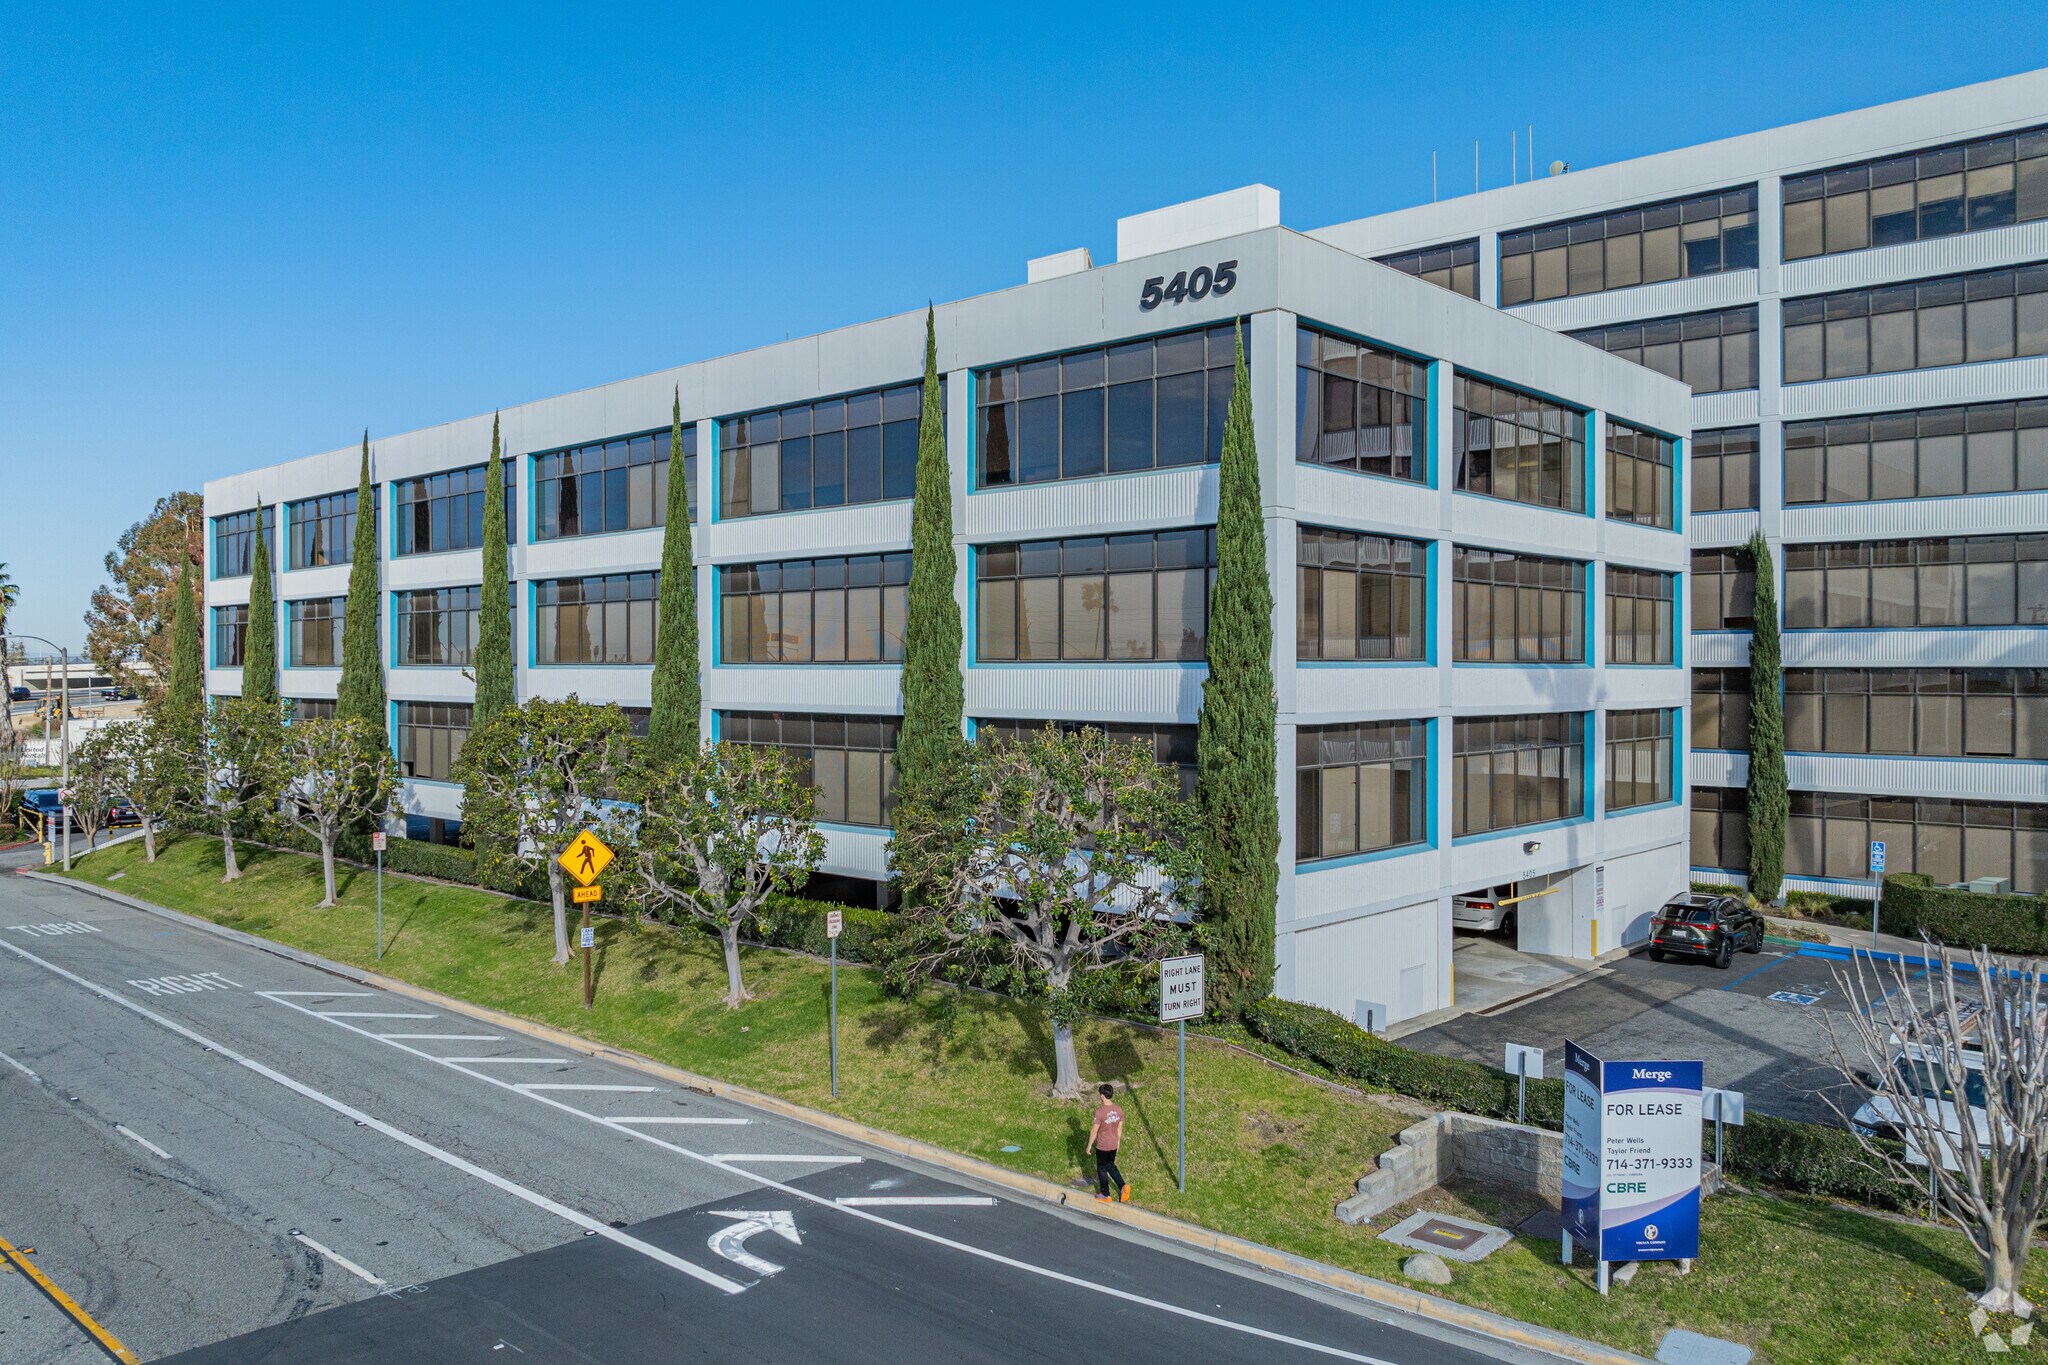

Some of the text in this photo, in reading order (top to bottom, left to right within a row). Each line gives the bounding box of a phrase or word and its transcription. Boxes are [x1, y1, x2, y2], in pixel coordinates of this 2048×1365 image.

[1140, 260, 1238, 310] 5405
[577, 890, 598, 898] AHEAD
[6, 921, 102, 937] TURN
[1164, 965, 1201, 978] RIGHT LANE
[126, 971, 244, 996] RIGHT
[1170, 982, 1196, 994] MUST
[1164, 998, 1201, 1011] TURN RIGHT
[1574, 1052, 1590, 1073] Merge
[1632, 1068, 1672, 1083] Merge
[1566, 1080, 1595, 1111] FOR LEASE
[1607, 1103, 1683, 1116] FOR LEASE
[1564, 1131, 1599, 1168] 714-371-9333
[1607, 1147, 1628, 1156] Taylor
[1564, 1155, 1580, 1176] CBRE
[1606, 1157, 1693, 1170] 714-371-9333
[1606, 1182, 1647, 1194] CBRE
